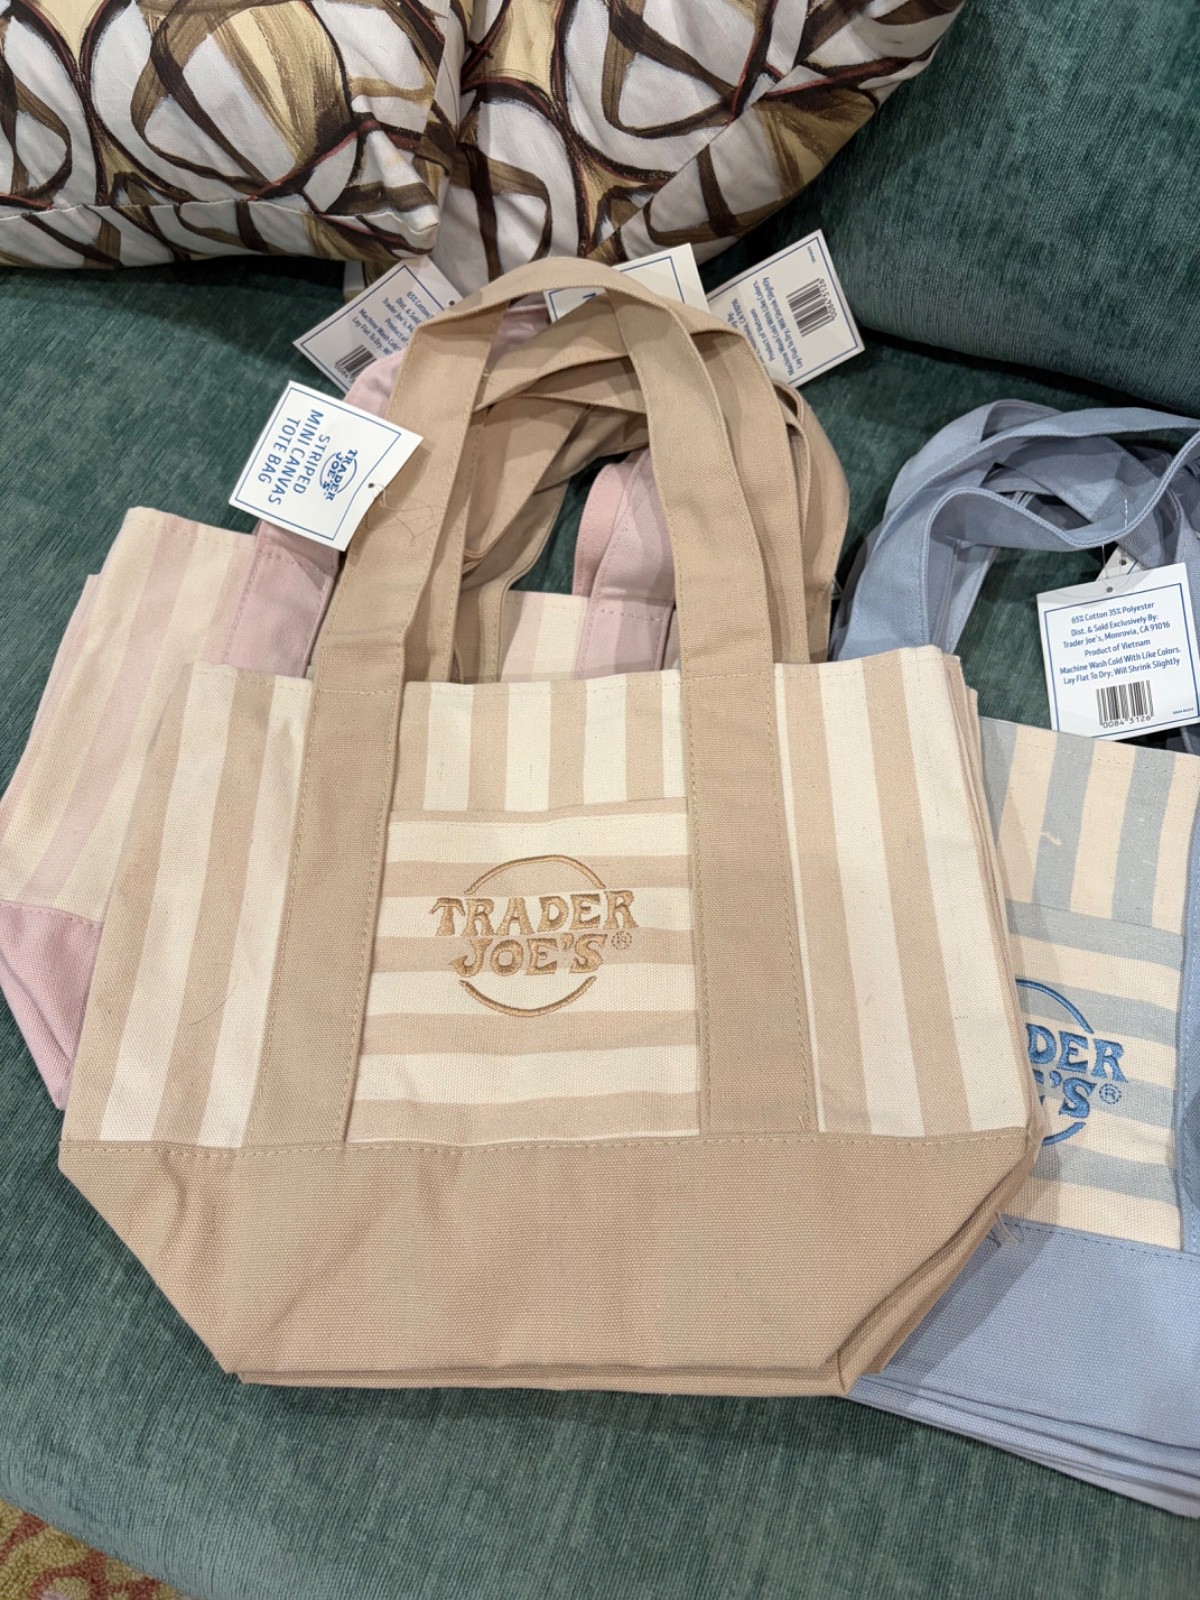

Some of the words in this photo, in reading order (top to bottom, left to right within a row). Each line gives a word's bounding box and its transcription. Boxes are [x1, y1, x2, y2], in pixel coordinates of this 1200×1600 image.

[762, 276, 775, 301] Slightly
[382, 297, 398, 314] Trader
[770, 299, 783, 320] Shrink
[358, 308, 379, 330] Machine
[384, 317, 404, 338] Product
[738, 314, 746, 325] CA
[750, 308, 764, 334] Vietnam
[777, 317, 786, 330] Will
[769, 324, 780, 339] Cold
[762, 338, 776, 362] Product
[775, 336, 785, 354] Wash
[790, 346, 799, 360] Flat
[782, 352, 795, 376] Machine
[795, 357, 804, 370] Lay
[273, 417, 301, 453] TOTE
[297, 409, 324, 446] MINI
[258, 453, 282, 484] BAG
[268, 447, 305, 505] CANVAS
[293, 434, 331, 494] STRIPED
[322, 452, 343, 491] JOE'S
[326, 449, 358, 501] TRADER
[1070, 614, 1085, 624] 65%
[1084, 611, 1108, 622] Cotton
[1108, 607, 1122, 617] 35%
[1122, 602, 1155, 614] Polyester
[1070, 628, 1087, 637] Dist.
[1087, 626, 1093, 634] &
[1093, 622, 1109, 632] Sold
[1109, 615, 1147, 629] Exclusively
[1147, 613, 1158, 623] By:
[1063, 639, 1084, 649] Trader
[1085, 634, 1105, 646] Joe's,
[1104, 628, 1139, 640] Monrovia,
[1139, 624, 1150, 634] CA
[1149, 620, 1171, 632] 91016
[1084, 646, 1112, 657] Product
[1112, 642, 1120, 652] of
[1120, 639, 1151, 650] Vietnam
[1059, 664, 1088, 675] Machine
[1088, 660, 1108, 669] Wash
[1107, 656, 1124, 666] Cold
[1123, 653, 1141, 663] With
[1141, 651, 1157, 660] Like
[1156, 647, 1182, 657] Colors.
[1063, 677, 1075, 686] Lay
[1075, 674, 1090, 683] Flat
[1089, 671, 1099, 680] To
[1098, 670, 1114, 679] Dry;
[1113, 666, 1128, 676] Will
[1127, 662, 1152, 674] Shrink
[1152, 657, 1180, 669] Slightly
[1102, 719, 1125, 729] 0084
[429, 889, 640, 937] TRADER
